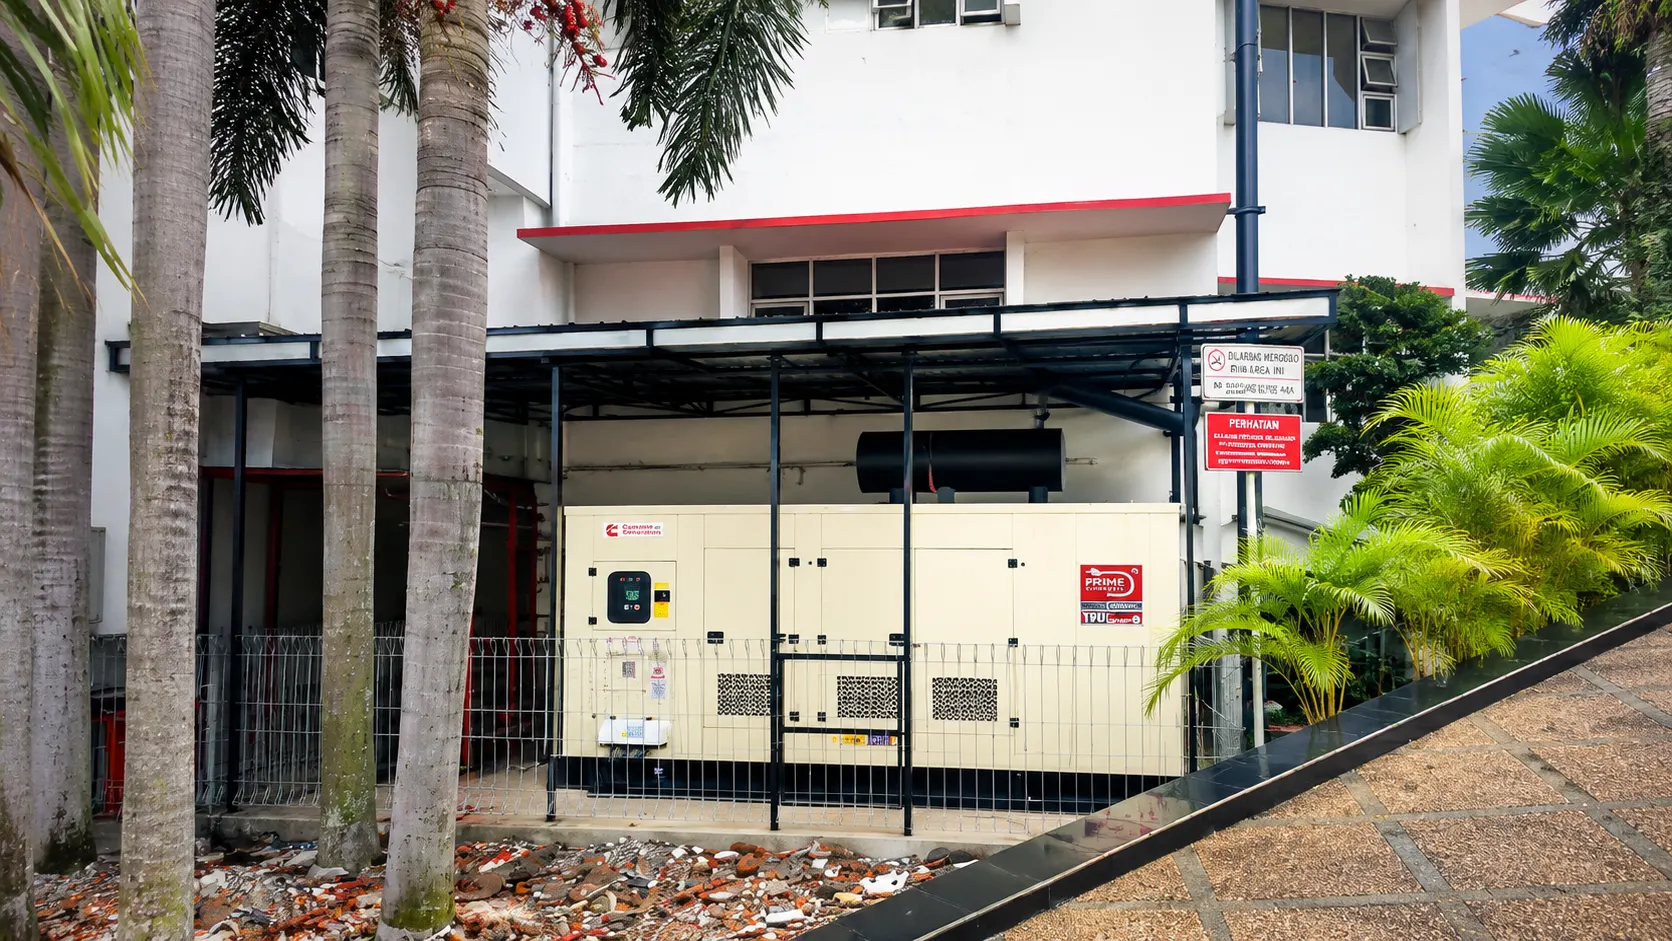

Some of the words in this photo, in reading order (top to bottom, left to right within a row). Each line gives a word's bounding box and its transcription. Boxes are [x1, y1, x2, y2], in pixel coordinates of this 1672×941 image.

[1273, 366, 1284, 375] INI
[1229, 418, 1279, 430] PERHATIAN
[1085, 577, 1125, 587] PRIME
